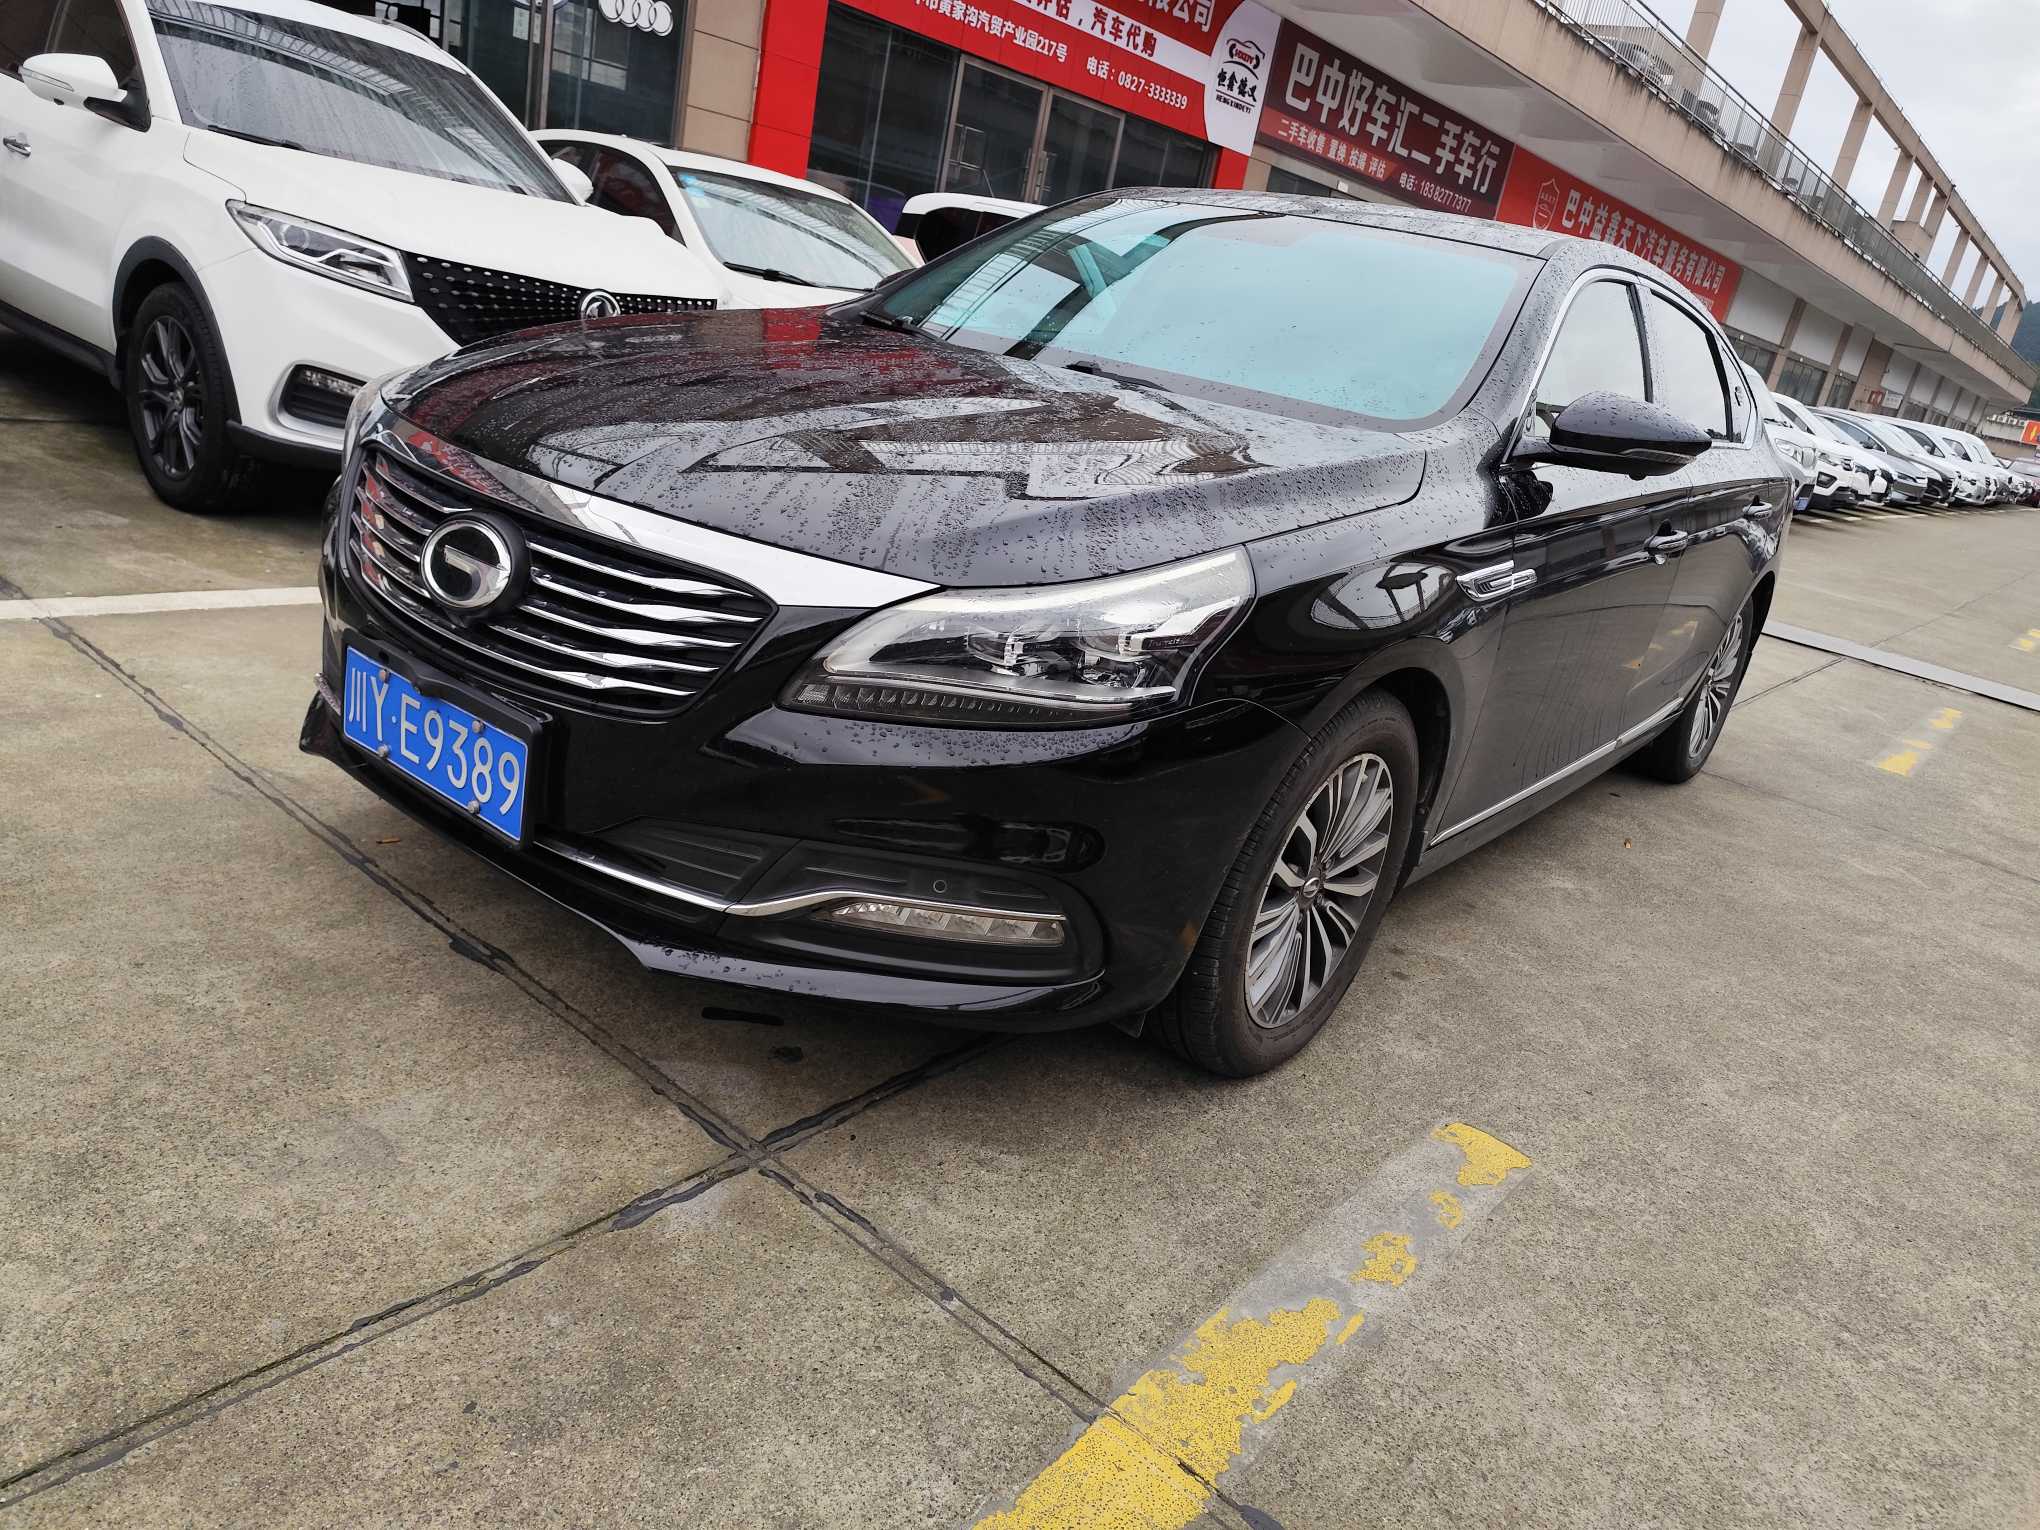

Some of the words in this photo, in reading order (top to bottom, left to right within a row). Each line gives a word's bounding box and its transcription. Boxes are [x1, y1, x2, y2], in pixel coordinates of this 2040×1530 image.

[1285, 42, 1500, 194] 巴中好车汇二手车行
